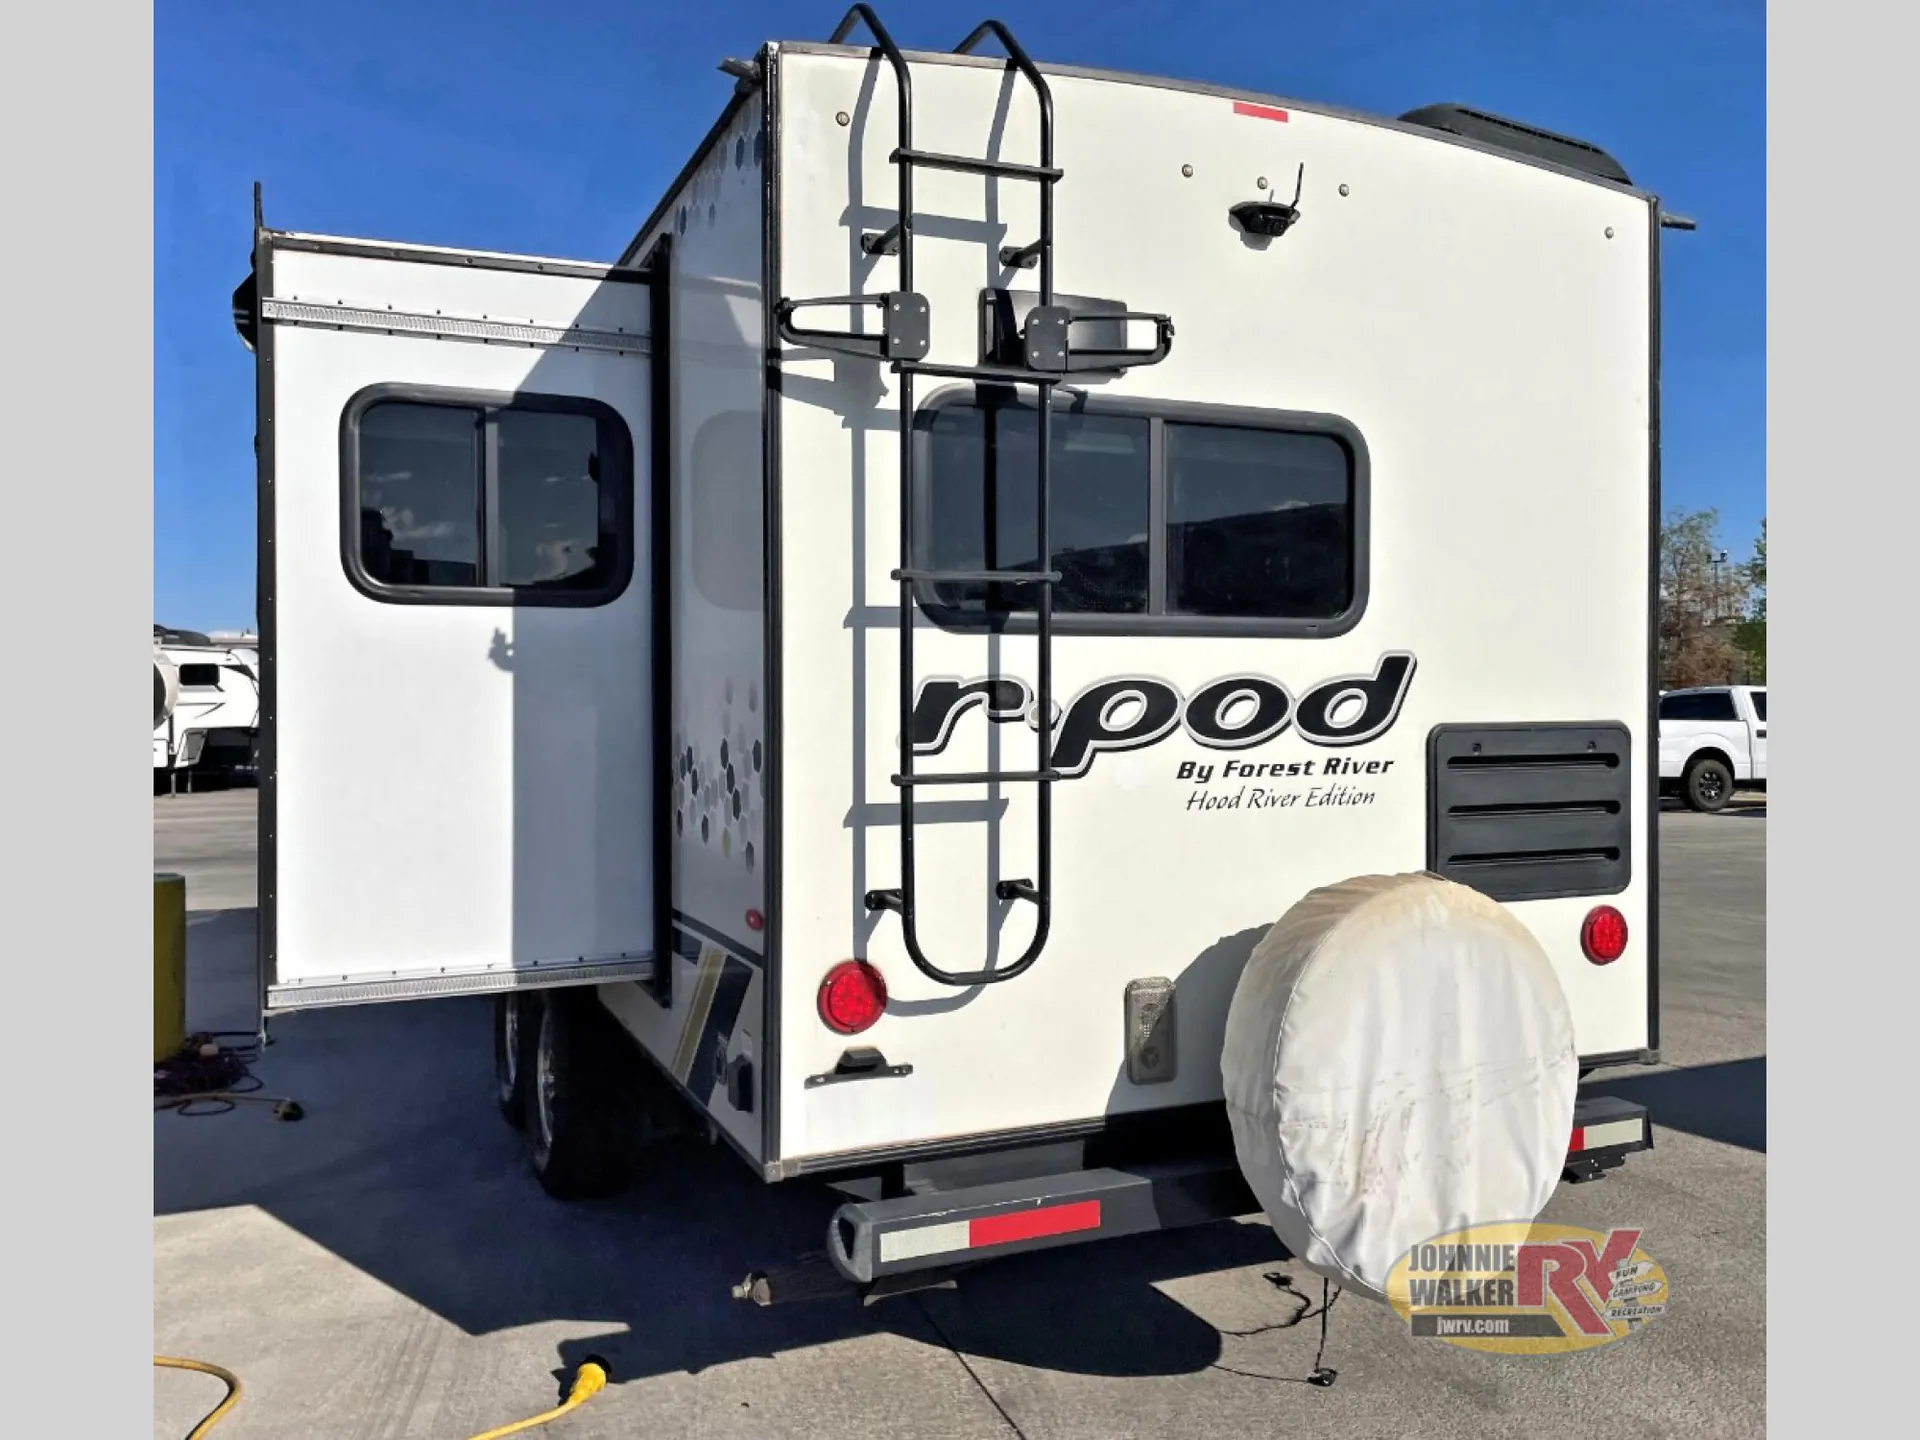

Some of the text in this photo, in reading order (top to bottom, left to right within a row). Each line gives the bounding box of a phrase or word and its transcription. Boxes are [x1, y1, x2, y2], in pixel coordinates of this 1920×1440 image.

[1177, 757, 1394, 783] By Forest River
[1186, 782, 1376, 811] Hood River Edition
